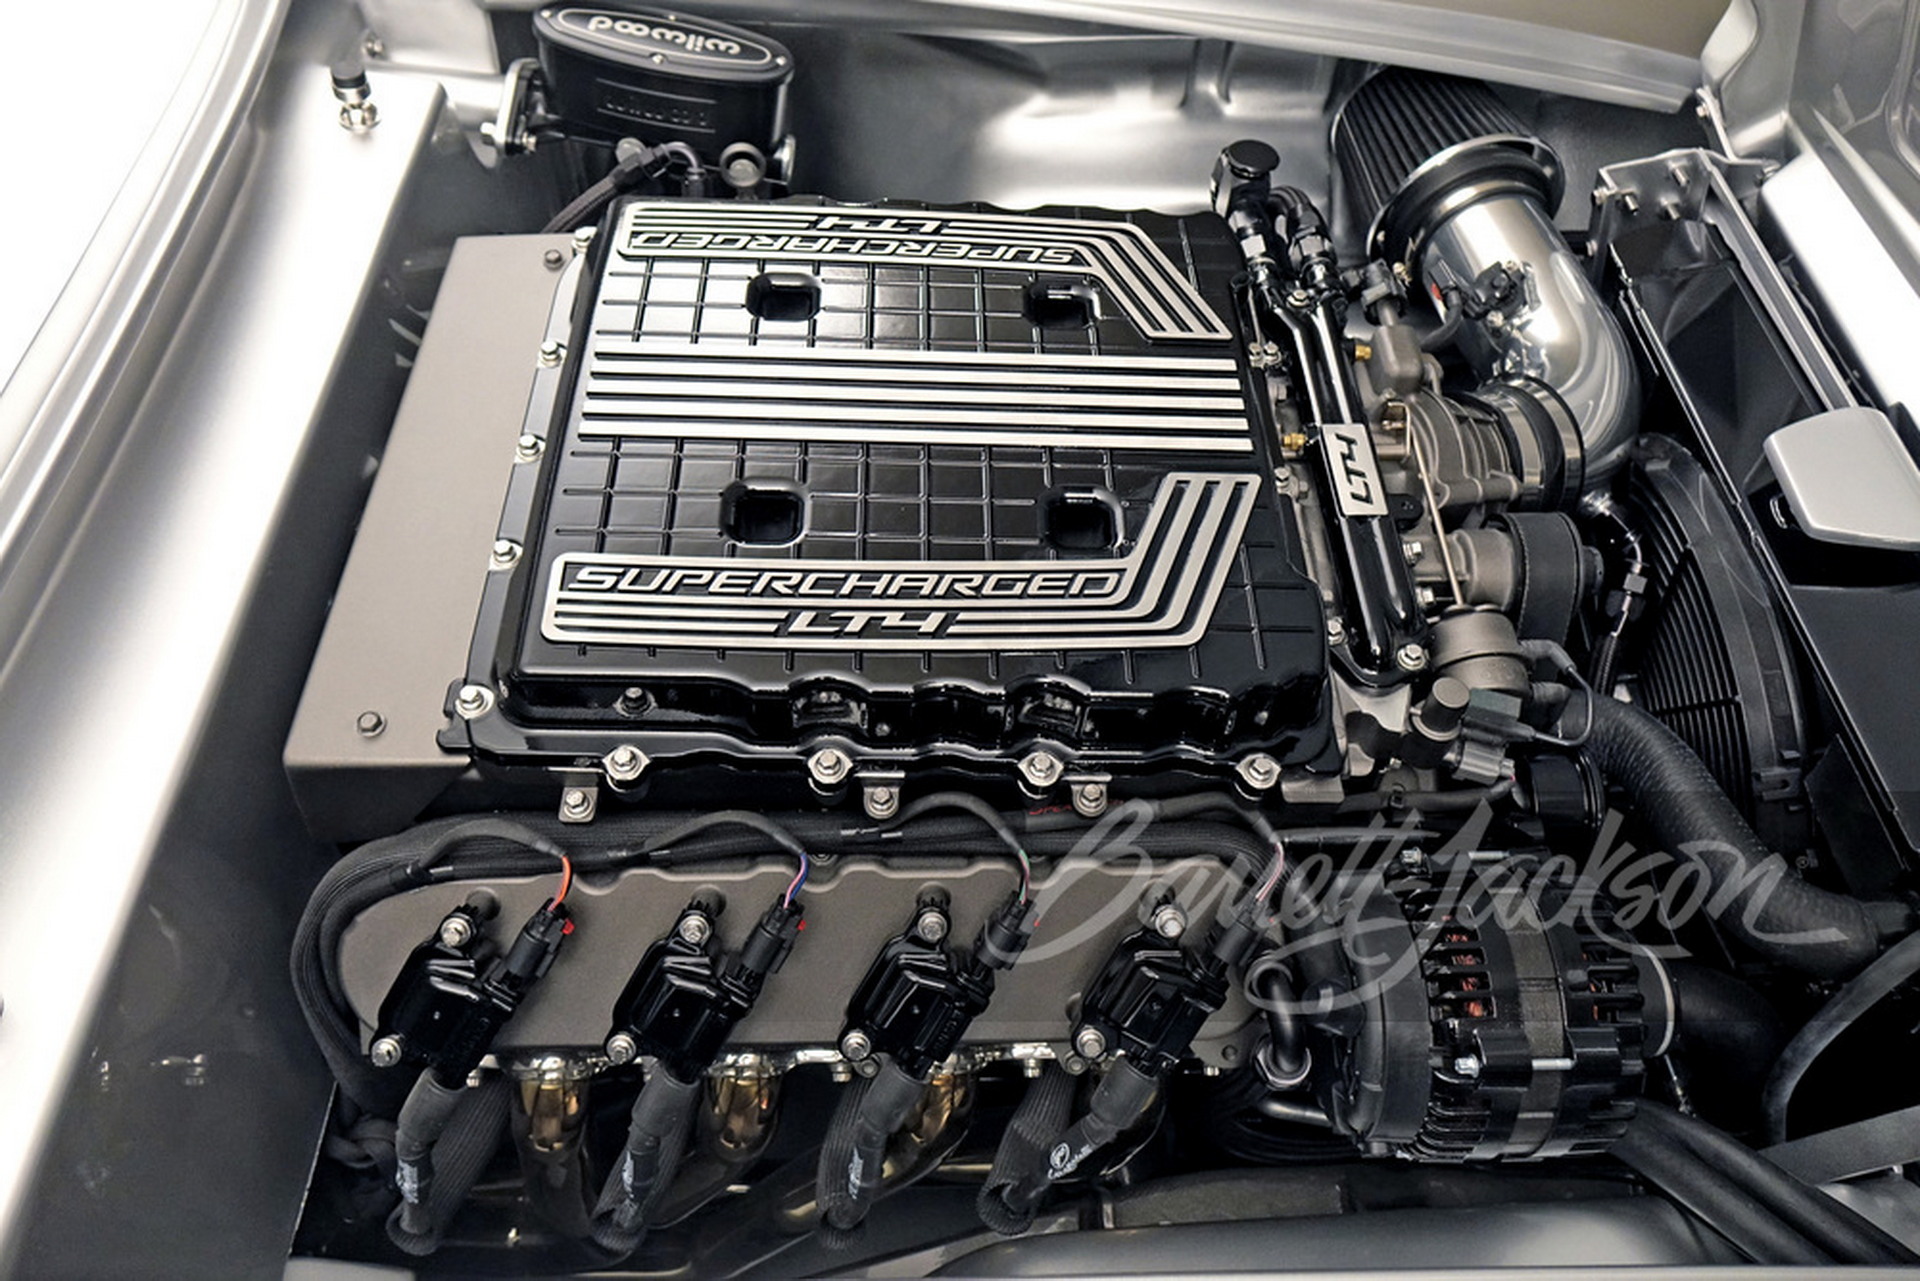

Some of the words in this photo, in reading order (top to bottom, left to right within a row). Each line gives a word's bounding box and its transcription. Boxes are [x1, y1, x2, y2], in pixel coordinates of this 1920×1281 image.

[586, 15, 741, 55] wilwood
[815, 214, 943, 234] LT4
[631, 232, 1075, 263] SUPERCHARGED
[1334, 431, 1375, 506] LT4
[568, 566, 1120, 597] SUPERCHARGED
[787, 611, 947, 634] LT4
